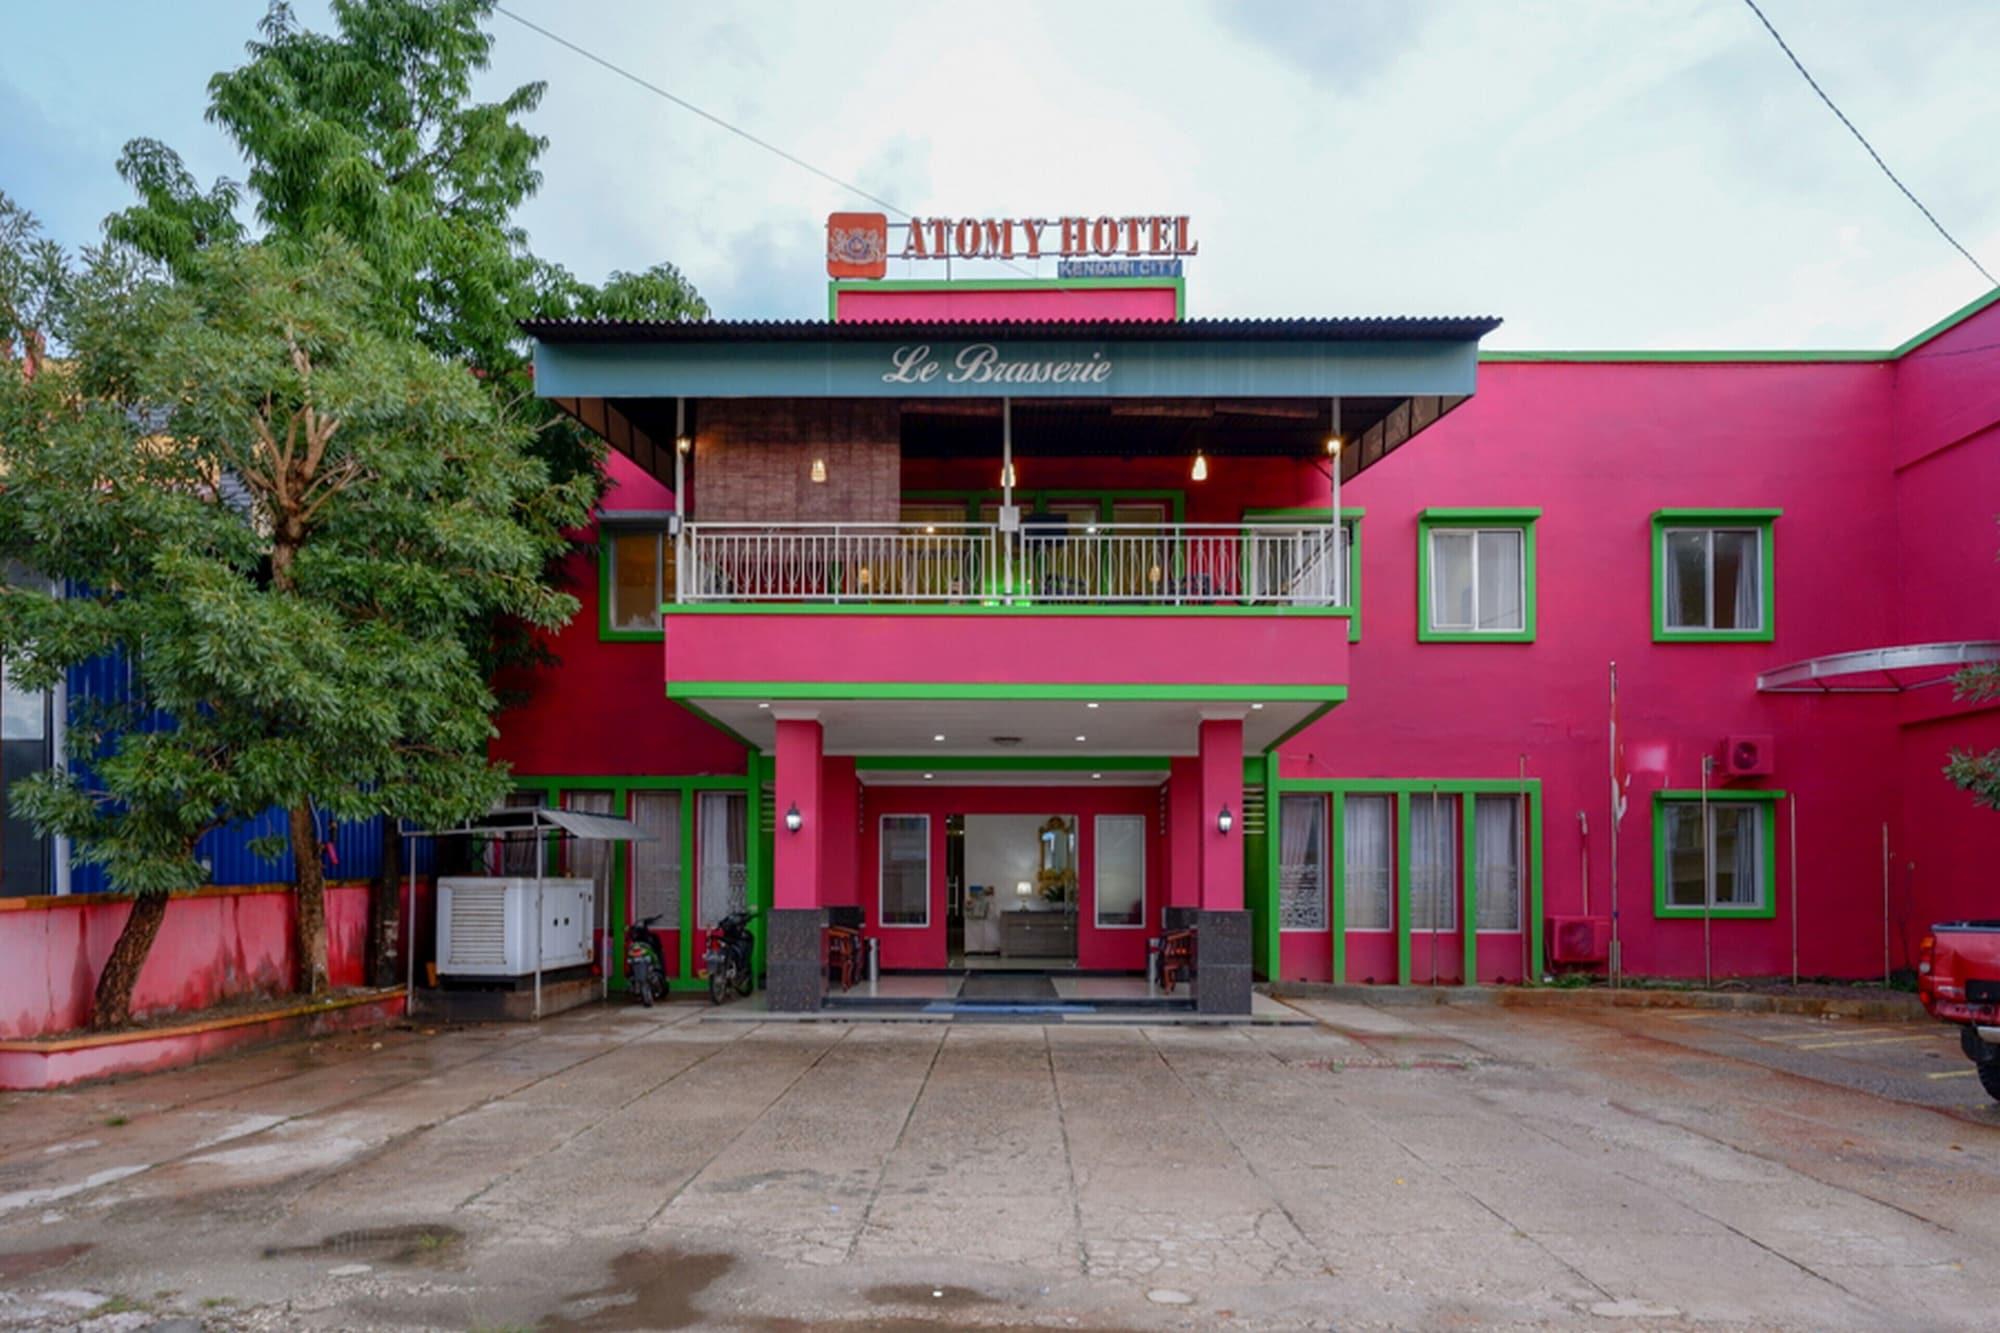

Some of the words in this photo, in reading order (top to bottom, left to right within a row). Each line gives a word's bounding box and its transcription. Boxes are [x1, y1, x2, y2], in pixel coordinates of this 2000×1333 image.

[903, 217, 1043, 259] ATOMY
[1059, 216, 1198, 257] HOTEL
[1059, 261, 1136, 277] KENDARI
[1140, 260, 1178, 276] CITY
[882, 344, 940, 384] Le
[947, 343, 1112, 384] Brasserie
